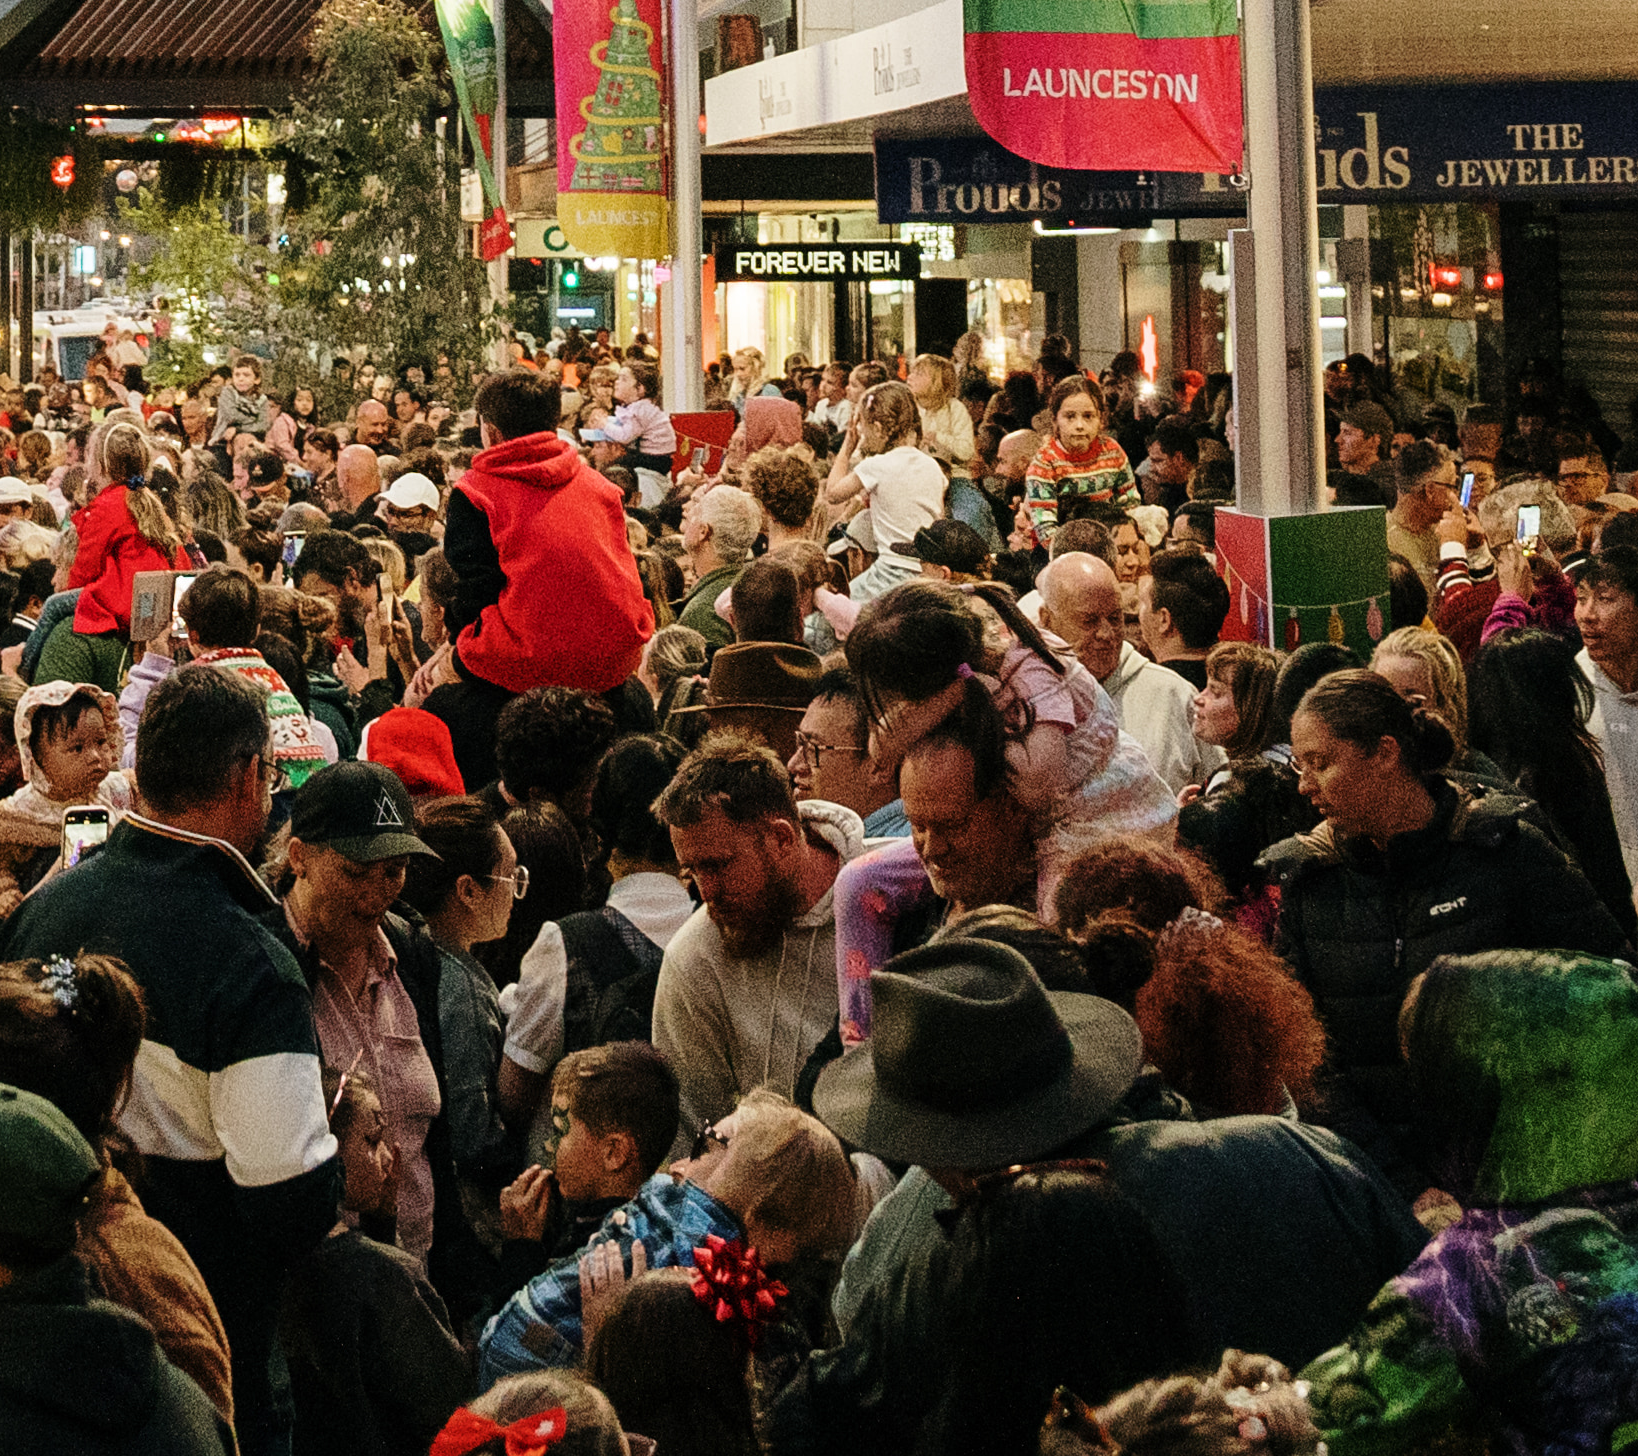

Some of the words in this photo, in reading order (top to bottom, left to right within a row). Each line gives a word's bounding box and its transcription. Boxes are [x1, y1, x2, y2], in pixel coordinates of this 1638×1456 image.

[1506, 123, 1584, 151] THE
[908, 157, 1062, 215] Prouds
[735, 250, 846, 275] FOREVER
[852, 250, 902, 275] NEW
